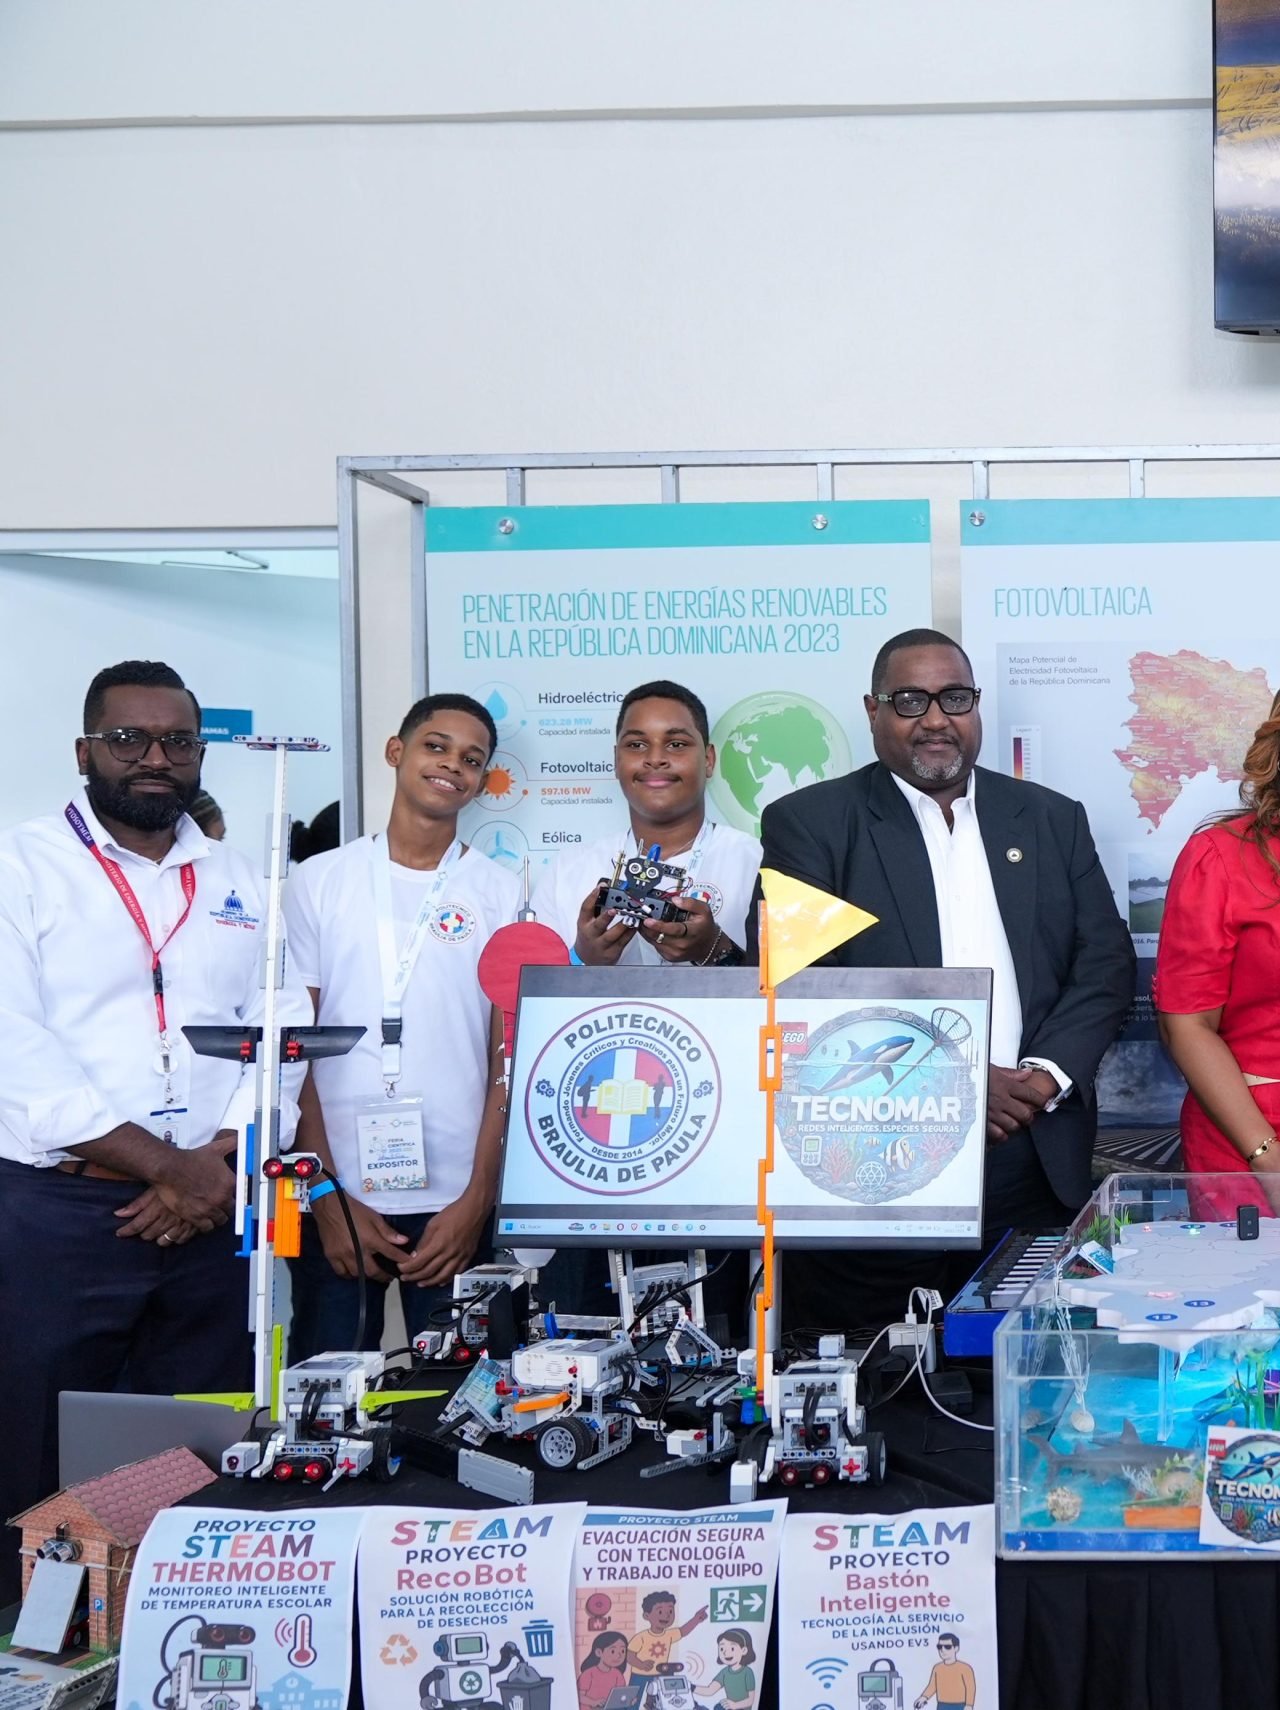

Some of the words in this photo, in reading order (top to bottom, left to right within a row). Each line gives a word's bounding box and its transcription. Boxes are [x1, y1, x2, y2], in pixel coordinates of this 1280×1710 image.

[463, 589, 606, 623] PENETRACIÓN
[612, 592, 638, 620] DE
[645, 586, 746, 620] ENERGÍAS
[752, 586, 887, 618] RENOVABLES
[994, 587, 1152, 617] FOTOVOLTAICA
[464, 630, 490, 658] EN
[496, 629, 523, 658] LA
[529, 623, 642, 657] REPÚBLICA
[647, 624, 779, 655] DOMINICANA
[784, 623, 840, 653] 2023
[1009, 657, 1030, 665] Mapa
[1054, 666, 1098, 674] Fotovoltaica
[1030, 678, 1065, 686] República
[538, 692, 626, 703] Hidroeléctric
[574, 718, 592, 726] MW
[539, 728, 577, 736] Capacidad
[540, 761, 615, 774] Fotovoltaic
[541, 788, 570, 796] 597.16
[573, 787, 591, 795] MW
[541, 797, 579, 806] Capacidad
[542, 832, 581, 843] Eólica
[564, 1013, 701, 1062] POLITECNICO
[583, 1039, 617, 1060] Críticos
[627, 1037, 667, 1059] Creativos
[665, 1058, 680, 1078] para
[563, 1061, 584, 1097] Jóvenes
[676, 1079, 683, 1092] un
[670, 1094, 685, 1124] Futuro
[791, 1095, 961, 1123] TECNOMAR
[562, 1100, 584, 1144] Formando
[883, 1125, 919, 1133] ESPECIES
[922, 1125, 959, 1133] SEGURAS
[538, 1114, 609, 1182] BRAULIA
[617, 1164, 647, 1183] DE
[651, 1114, 706, 1173] PAULA
[591, 1146, 620, 1159] DESDE
[622, 1148, 643, 1159] 2014
[368, 1160, 418, 1169] EXPOSITOR
[193, 1520, 316, 1533] PROYECTO
[618, 1516, 690, 1525] PROYECTO
[694, 1514, 739, 1523] STEAM
[391, 1516, 553, 1545] STEAM
[583, 1528, 691, 1545] EVACUACIÓN
[697, 1528, 765, 1543] SEGURA
[813, 1521, 970, 1551] STEAM
[182, 1534, 314, 1559] STEAM
[406, 1543, 527, 1565] PROYECTO
[598, 1549, 631, 1563] CON
[638, 1543, 745, 1562] TECNOLOGÍA
[830, 1551, 950, 1570] PROYECTO
[153, 1561, 336, 1583] THERMOBOT
[397, 1563, 527, 1590] RecoBot
[583, 1568, 592, 1581] Y
[598, 1566, 672, 1580] TRABAJO
[678, 1565, 698, 1578] EN
[704, 1563, 763, 1580] EQUIPO
[846, 1569, 929, 1590] Bastón
[148, 1586, 232, 1597] MONITOREO
[238, 1585, 326, 1596] INTELIGENTE
[390, 1592, 459, 1606] SOLUCIÓN
[464, 1588, 533, 1601] ROBÓTICA
[141, 1601, 158, 1610] DE
[163, 1600, 262, 1610] TEMPERATURA
[268, 1598, 332, 1608] ESCOLAR
[380, 1609, 415, 1619] PARA
[419, 1607, 435, 1617] LA
[440, 1600, 534, 1615] RECOLECCIÓN
[820, 1592, 950, 1613] Inteligente
[418, 1619, 433, 1628] DE
[438, 1615, 508, 1628] DESECHOS
[802, 1614, 884, 1629] TECNOLOGÍA
[888, 1615, 904, 1623] AL
[908, 1613, 965, 1623] SERVICIO
[832, 1630, 848, 1639] DE
[853, 1629, 868, 1637] LA
[872, 1623, 940, 1636] INCLUSIÓN
[851, 1639, 904, 1650] USANDO
[908, 1638, 929, 1647] EV3
